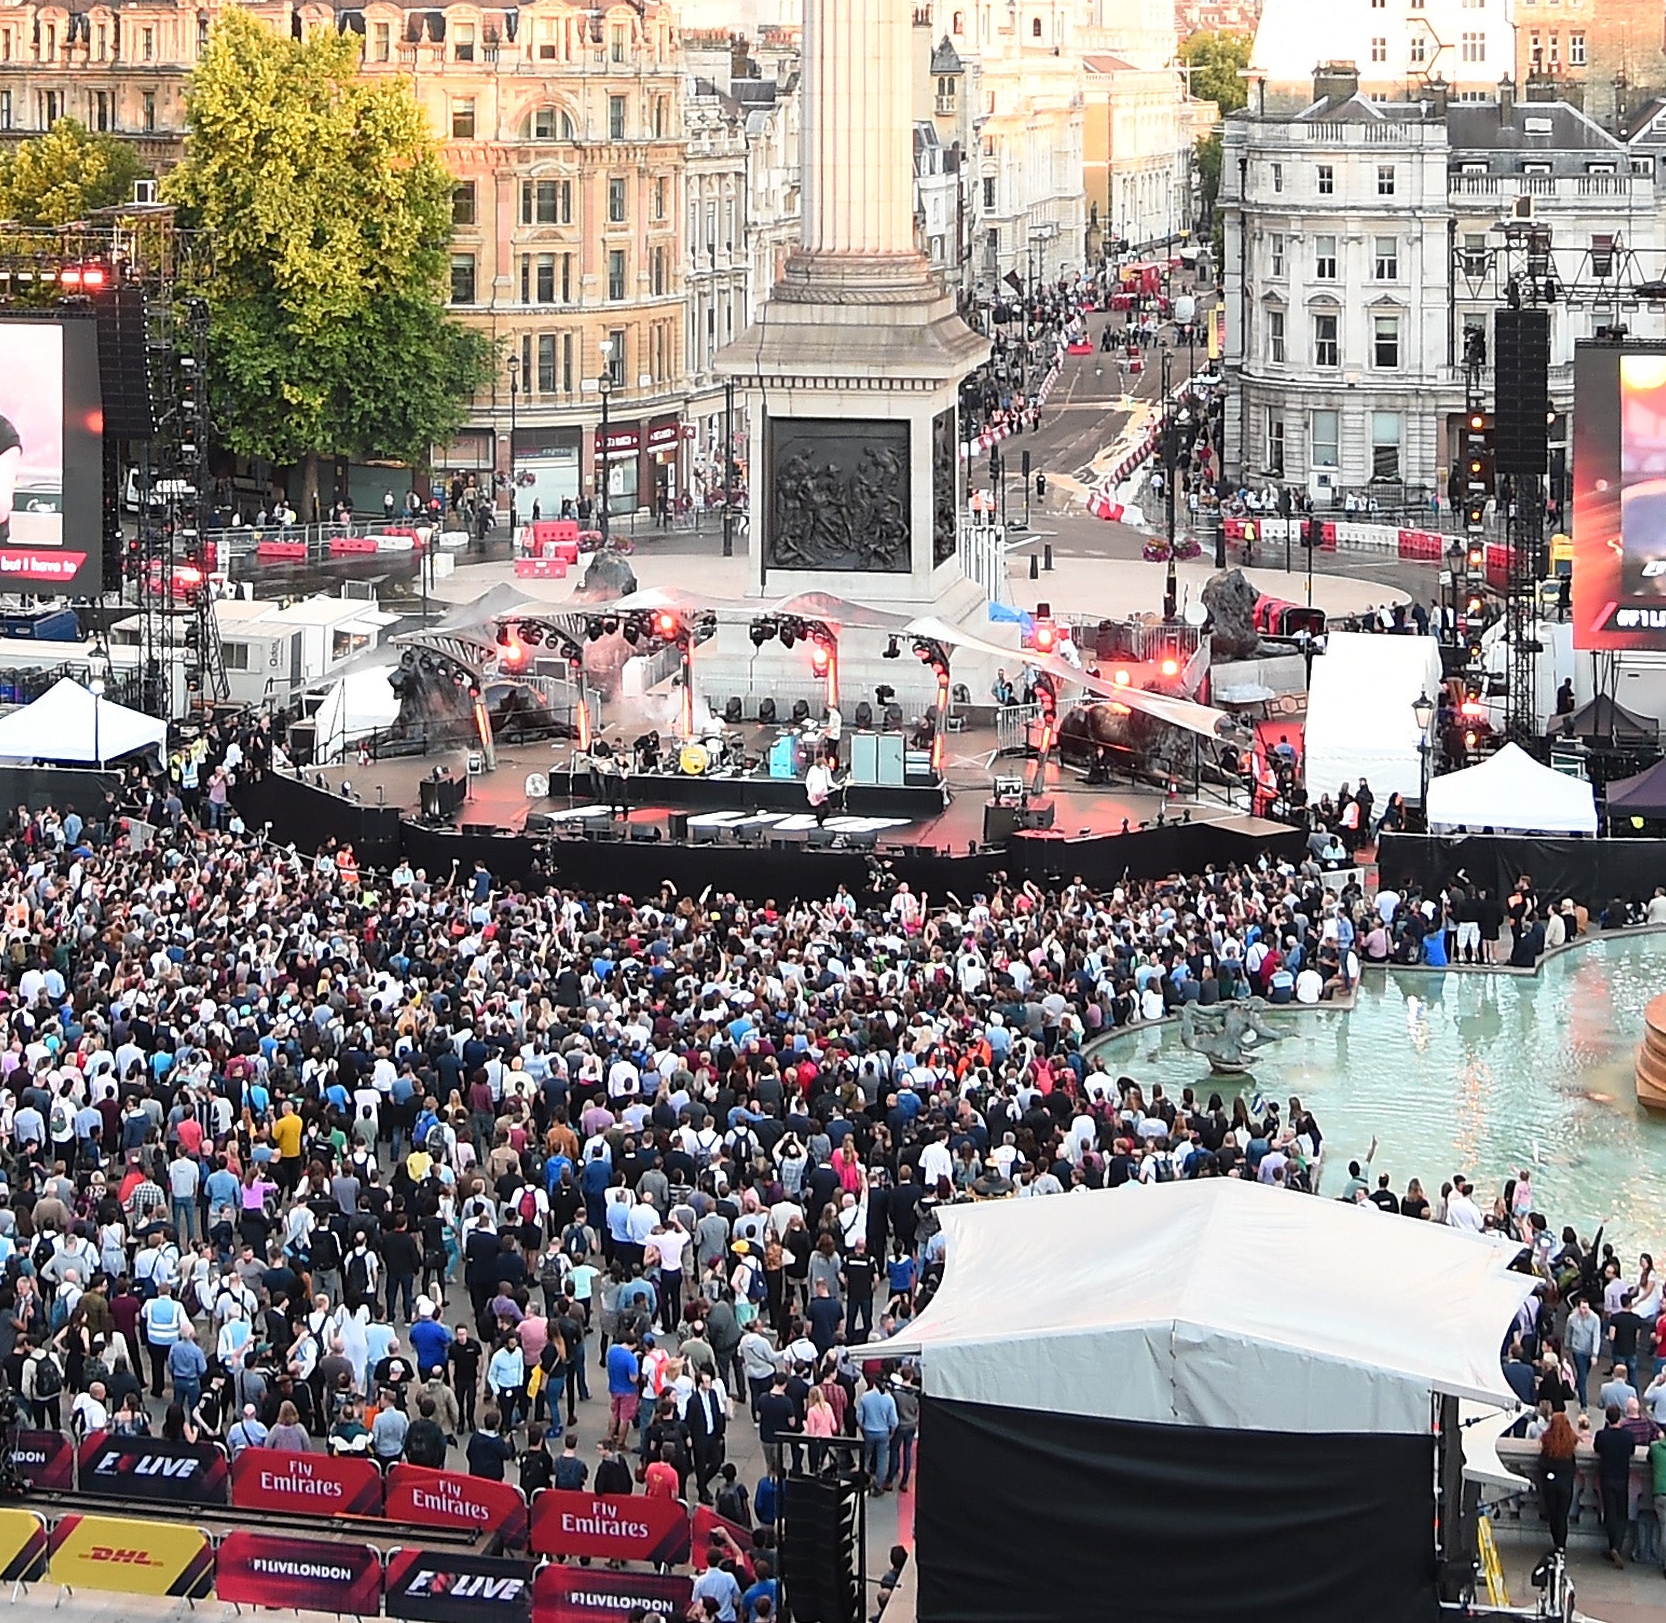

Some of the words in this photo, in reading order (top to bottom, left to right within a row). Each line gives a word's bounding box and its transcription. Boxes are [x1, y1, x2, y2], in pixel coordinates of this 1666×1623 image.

[0, 556, 21, 571] but
[30, 557, 61, 573] have
[63, 560, 77, 574] to
[134, 1455, 200, 1481] LIVE
[288, 1459, 314, 1478] Fly
[260, 1472, 343, 1500] Emirates
[438, 1479, 463, 1497] Fly
[411, 1489, 491, 1523] Emirates
[592, 1500, 618, 1519] Fly
[561, 1512, 650, 1540] Emirates
[90, 1545, 153, 1567] DHL
[253, 1558, 352, 1581] F1LIVELONDON
[450, 1572, 525, 1601] LIVE
